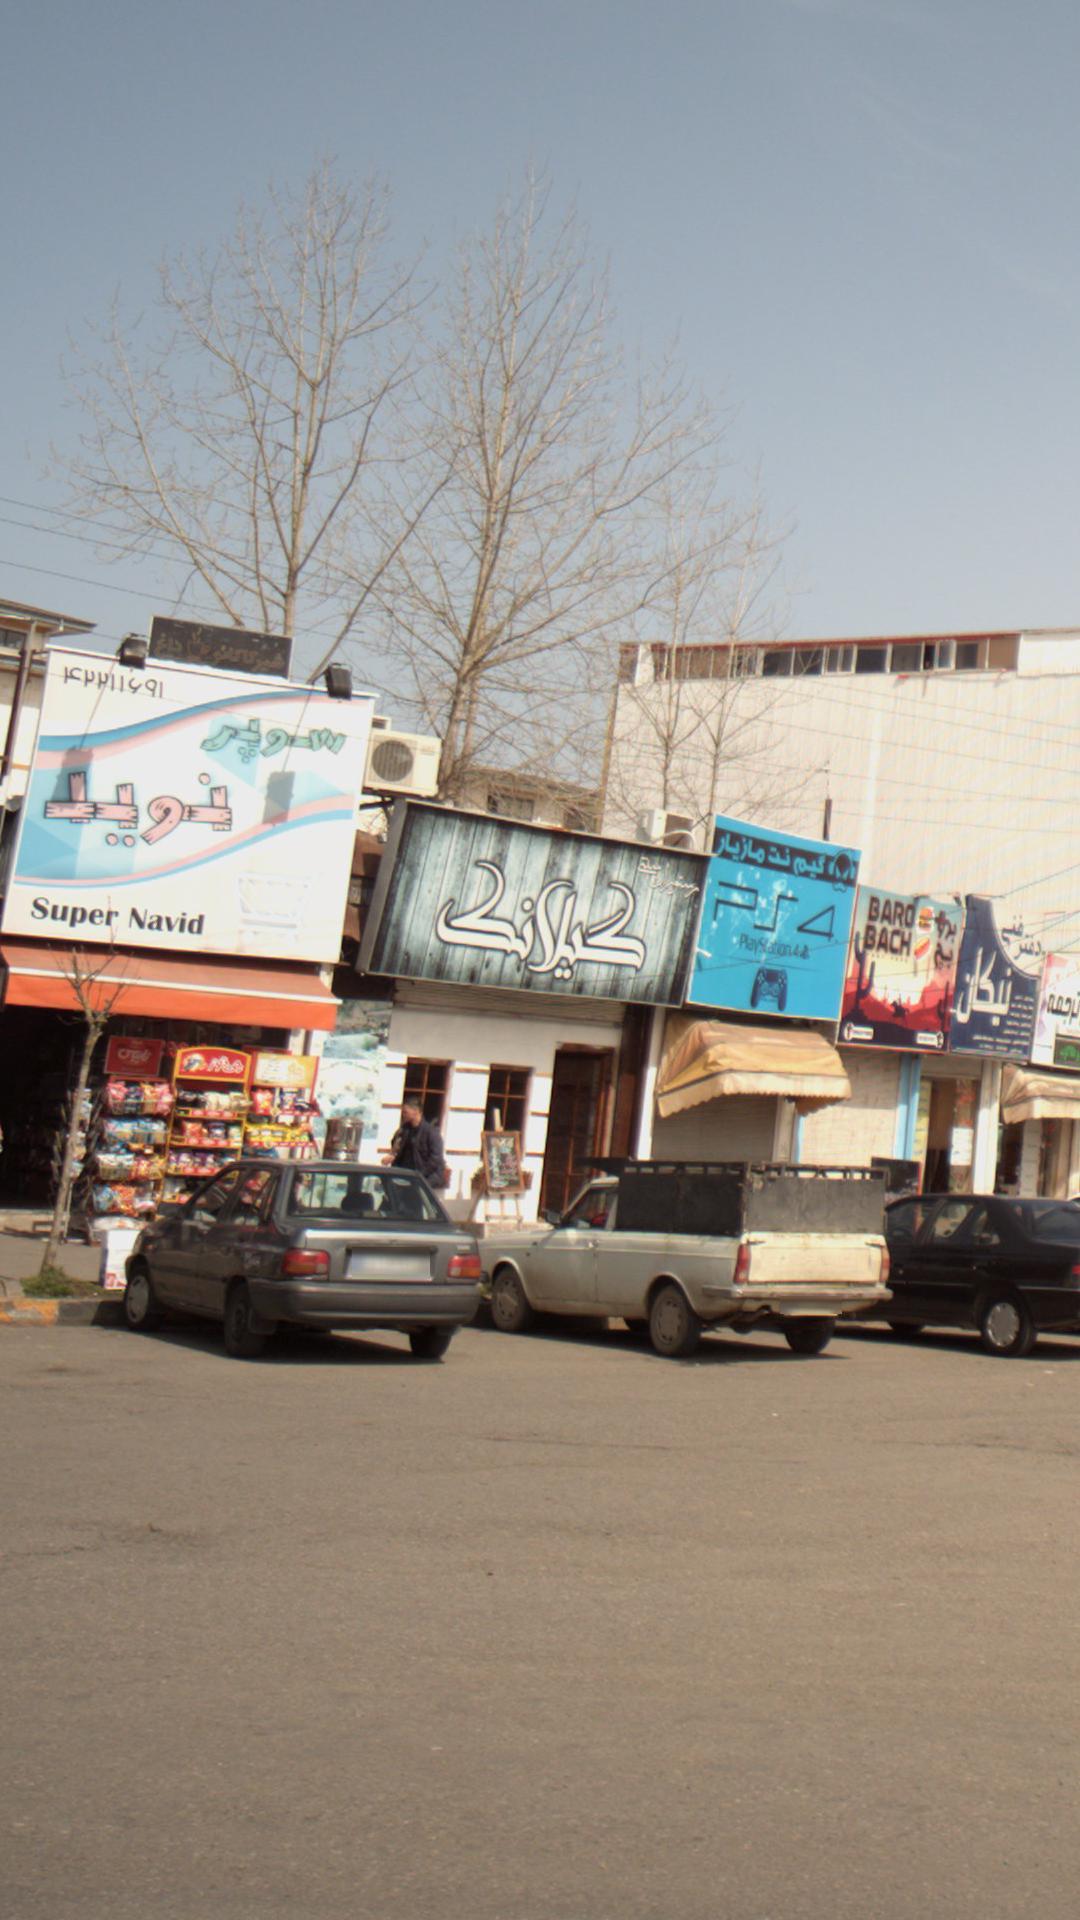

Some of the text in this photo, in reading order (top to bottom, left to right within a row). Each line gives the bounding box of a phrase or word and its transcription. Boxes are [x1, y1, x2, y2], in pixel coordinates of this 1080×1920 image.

[200, 718, 347, 764] سوپر
[44, 771, 232, 847] نوید
[716, 832, 827, 878] گیم نت مازیار
[31, 896, 205, 935] Super Navid
[713, 880, 836, 941] PS4
[868, 895, 916, 928] BARO
[864, 925, 912, 957] BACH
